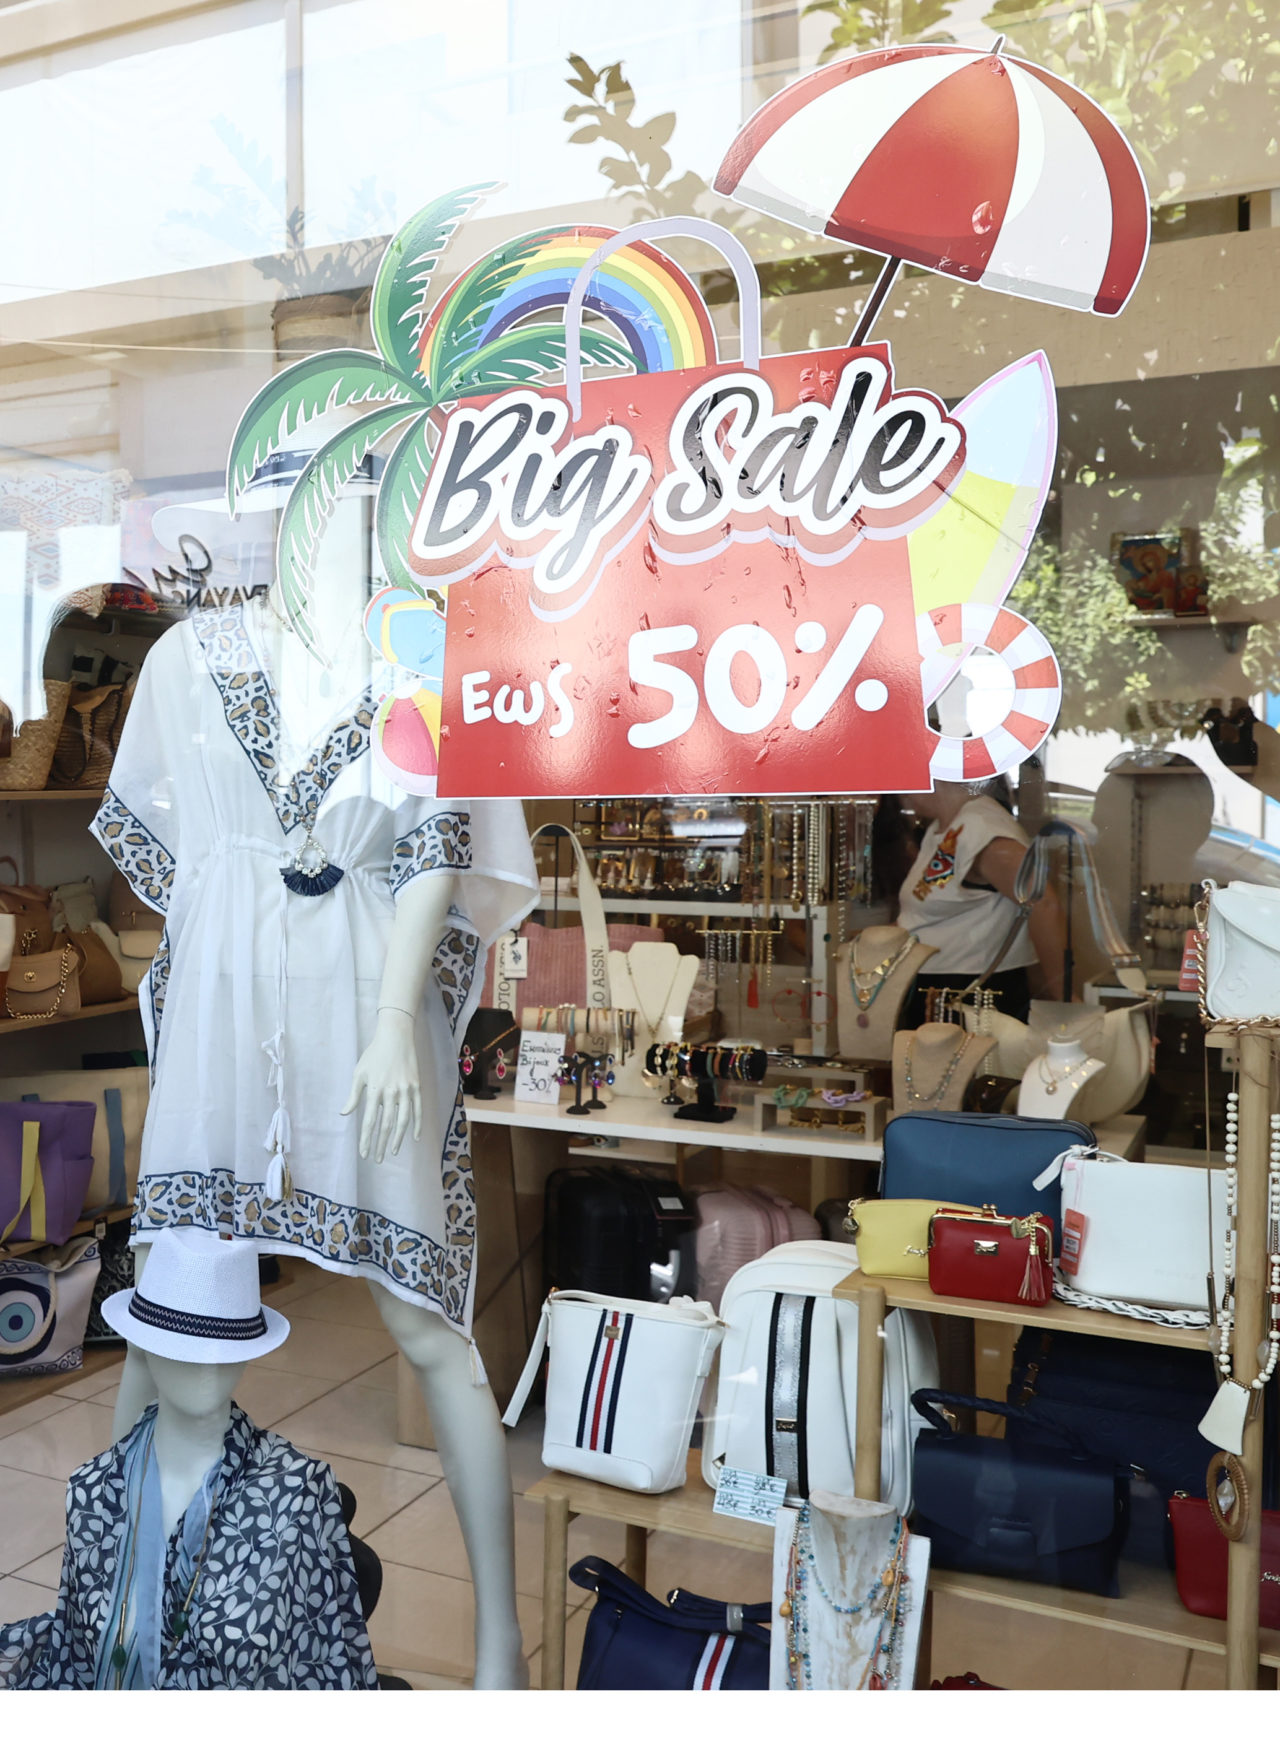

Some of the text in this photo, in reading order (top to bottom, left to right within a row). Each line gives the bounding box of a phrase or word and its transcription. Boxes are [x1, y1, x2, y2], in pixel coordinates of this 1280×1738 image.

[419, 362, 954, 588] Big Sale
[626, 603, 889, 750] 50%
[591, 945, 605, 988] ASSN.
